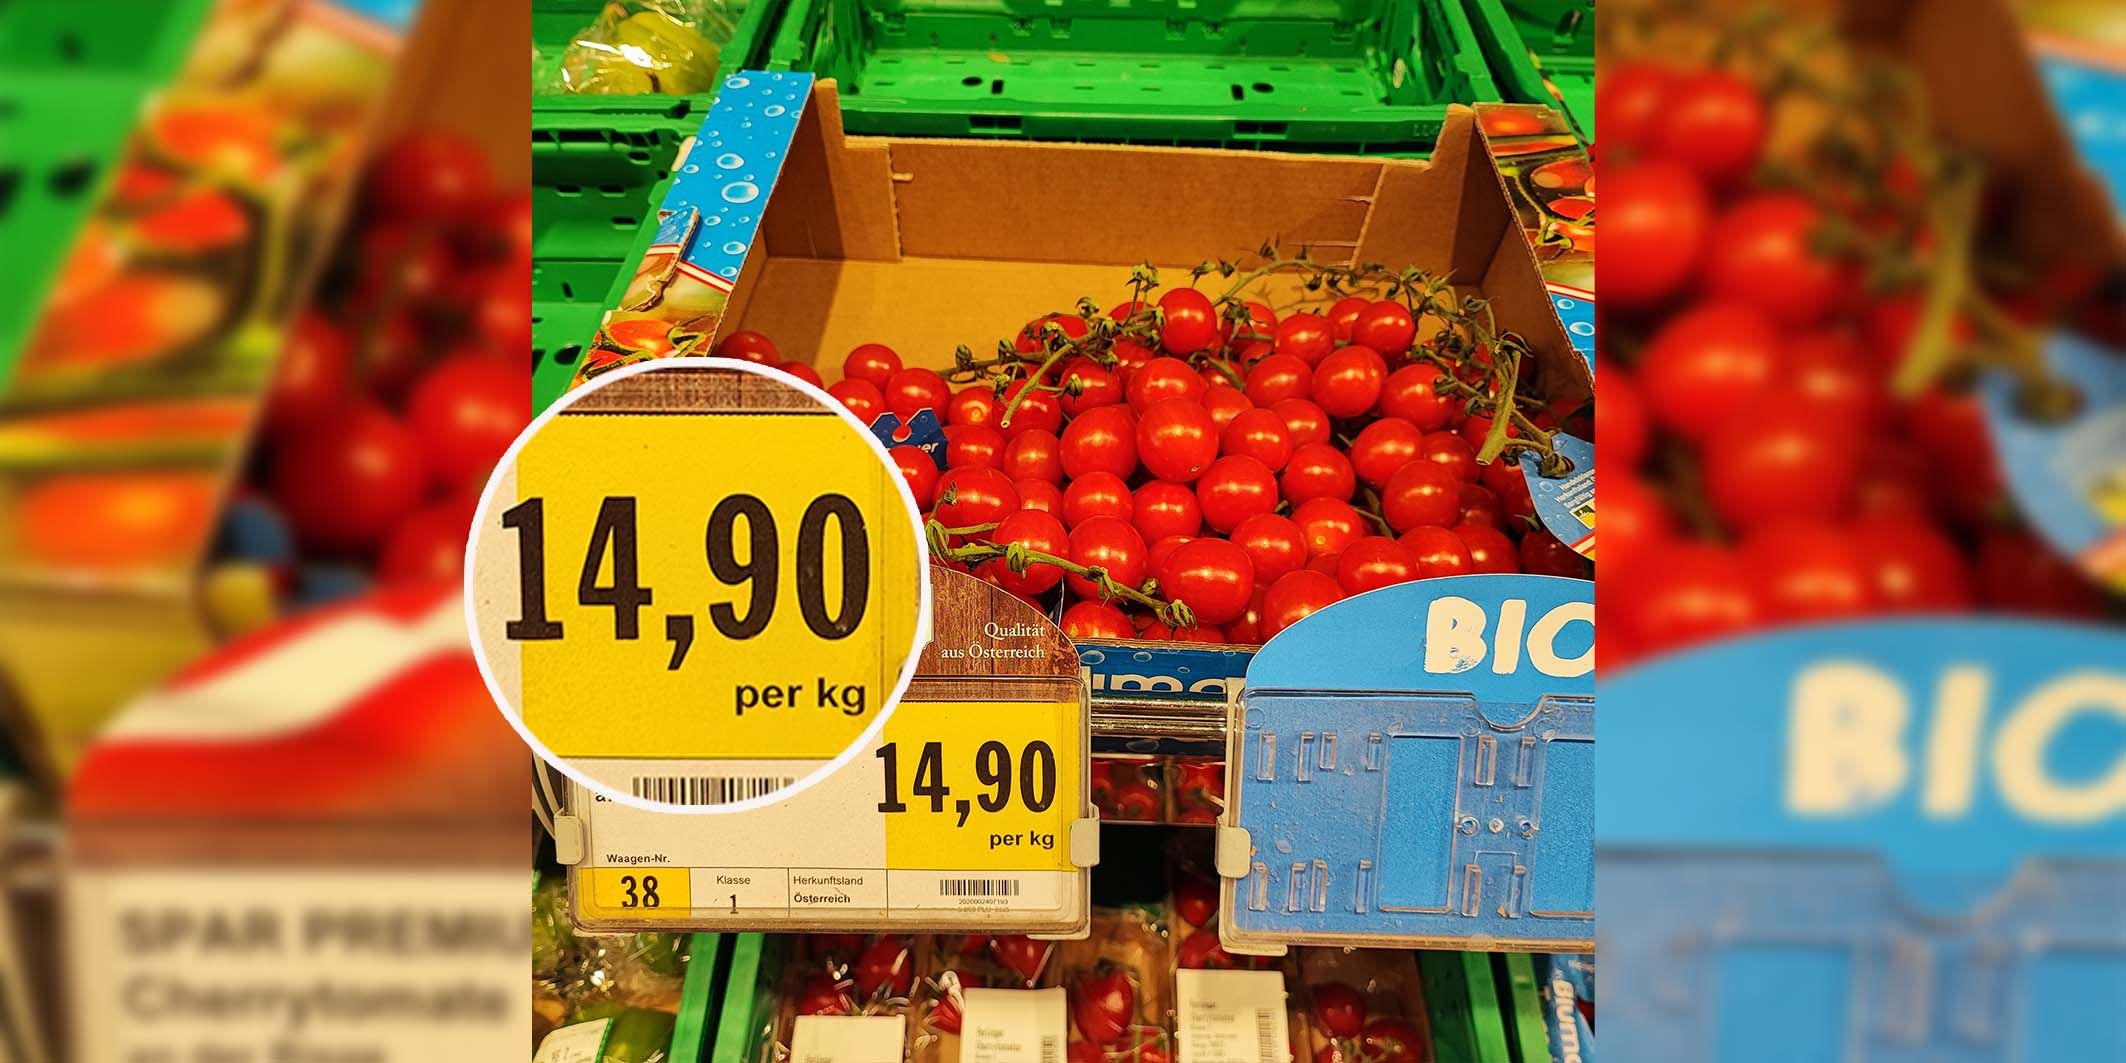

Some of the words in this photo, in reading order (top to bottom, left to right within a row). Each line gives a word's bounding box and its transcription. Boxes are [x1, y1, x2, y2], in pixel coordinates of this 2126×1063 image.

[502, 492, 870, 671] 14,90
[984, 622, 1046, 640] Qualität
[941, 648, 965, 659] aus
[969, 641, 1046, 659] Österreich
[735, 683, 803, 716] per
[817, 677, 867, 716] kg
[876, 740, 1057, 828] 14,90
[990, 833, 1023, 850] per
[1030, 830, 1055, 850] kg
[606, 853, 671, 865] Waagen-Nr.
[716, 875, 751, 885] Klasse
[793, 875, 864, 886] Herkunftsland
[620, 875, 660, 909] 38
[793, 891, 851, 903] Österreich
[729, 893, 739, 915] 1
